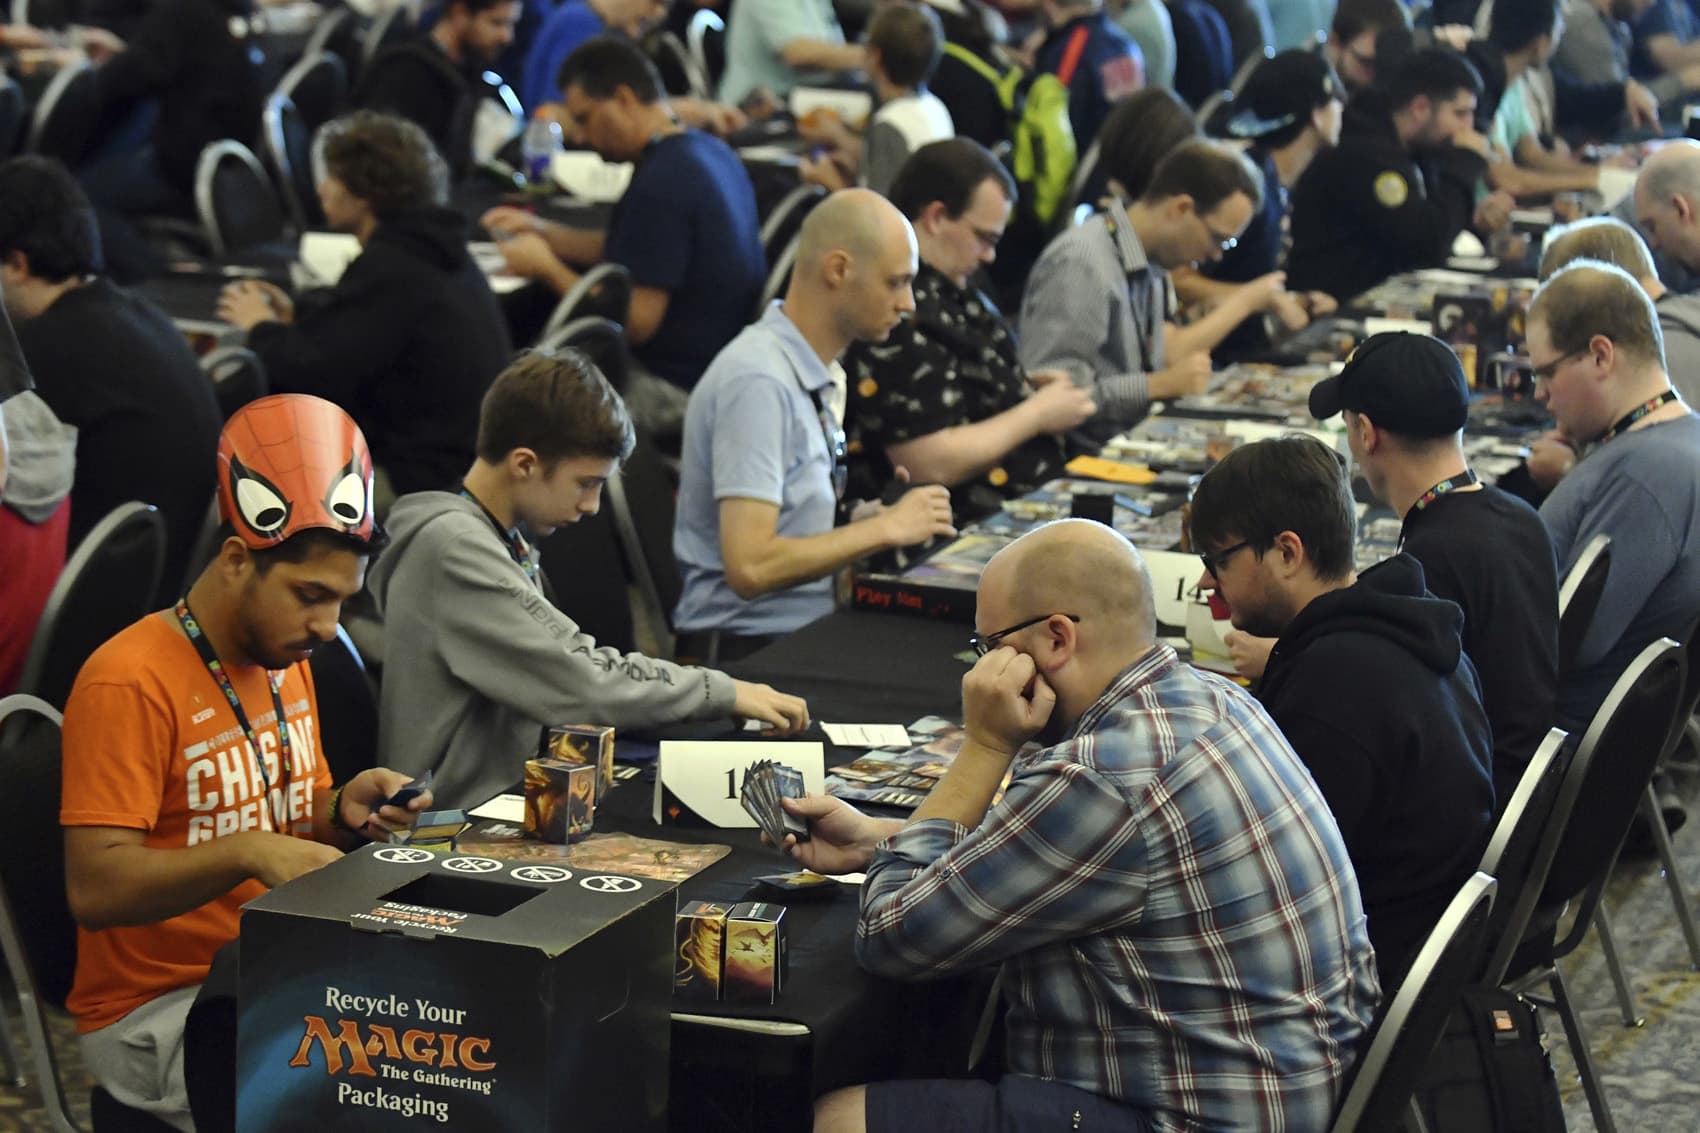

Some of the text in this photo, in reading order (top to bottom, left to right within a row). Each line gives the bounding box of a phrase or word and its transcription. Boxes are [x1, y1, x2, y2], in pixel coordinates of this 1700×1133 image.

[184, 715, 317, 812] CHASN
[724, 768, 741, 800] 1
[325, 986, 467, 1025] Recycle Your
[288, 1015, 497, 1077] MAGIC
[380, 1064, 492, 1095] The Gathering
[337, 1082, 449, 1123] Packaging
